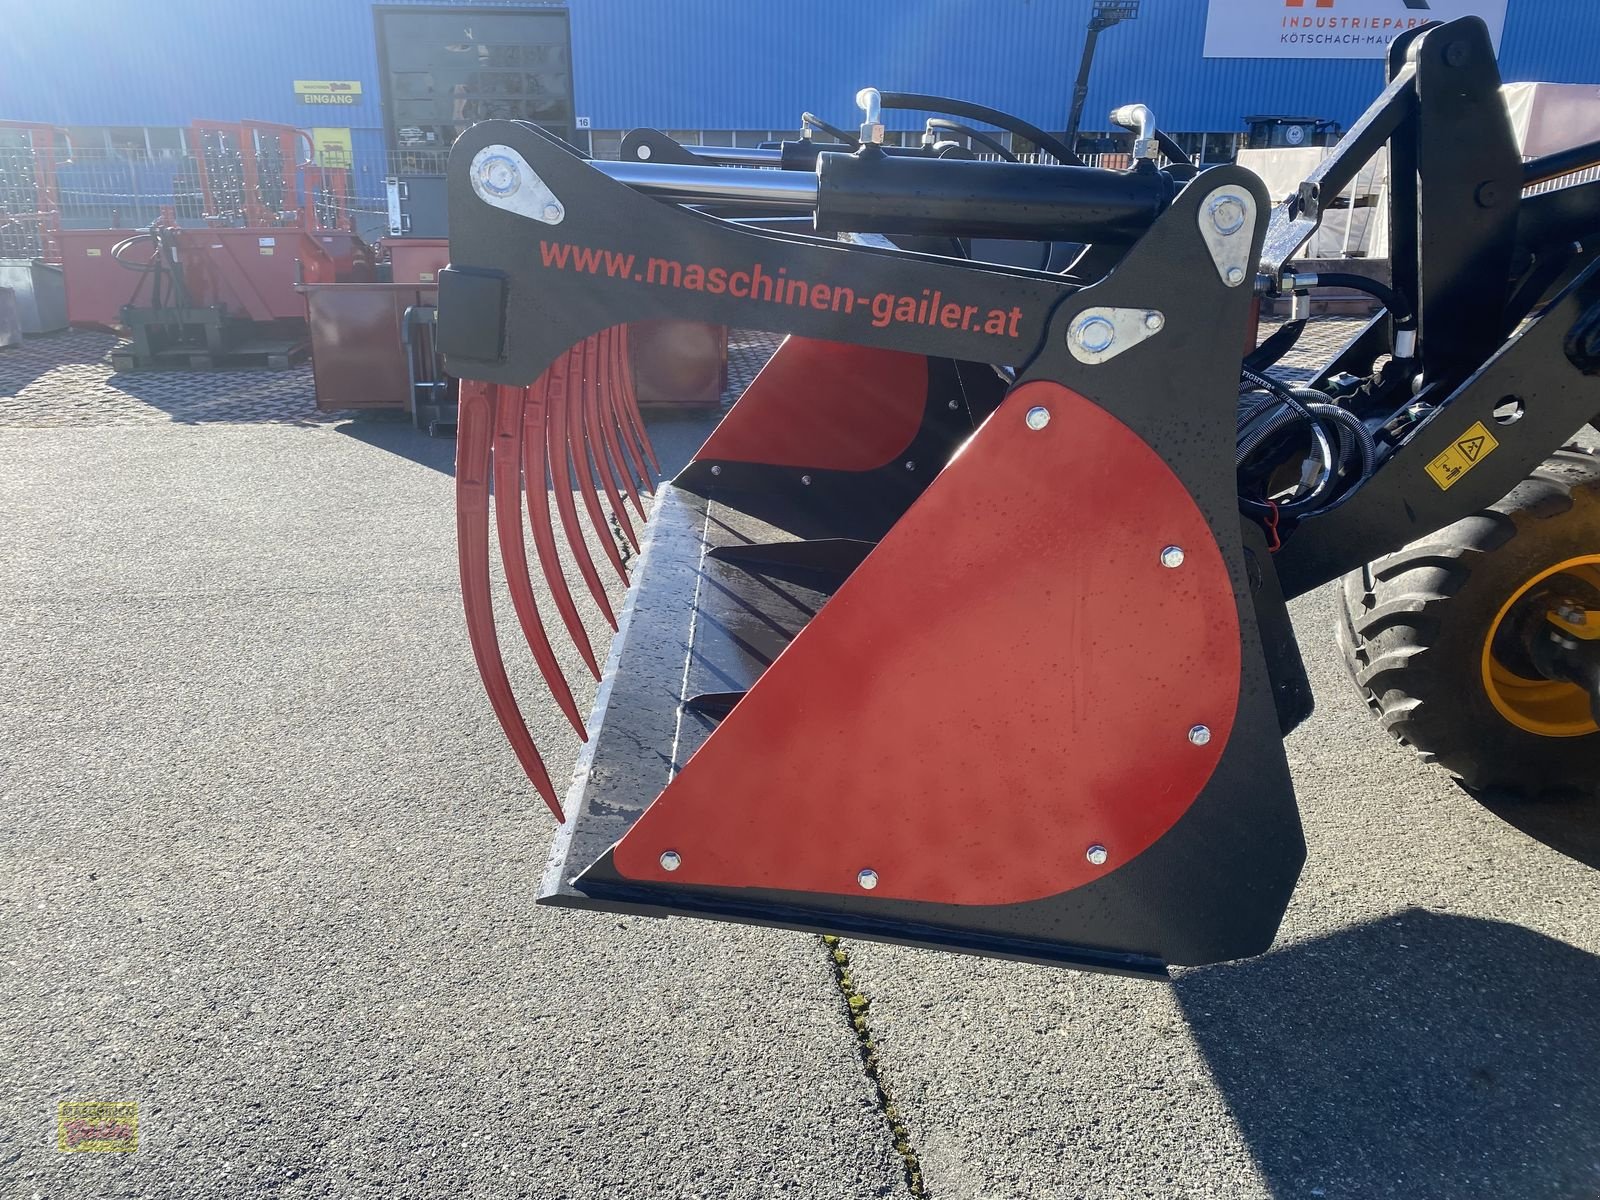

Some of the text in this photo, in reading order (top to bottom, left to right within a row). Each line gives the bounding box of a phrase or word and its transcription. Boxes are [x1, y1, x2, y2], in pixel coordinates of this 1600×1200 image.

[1281, 33, 1392, 45] KÖTSCHACH-MAU
[304, 95, 353, 103] EINGANG
[579, 118, 588, 126] 16
[539, 240, 1023, 338] www.maschinen-gailer.at
